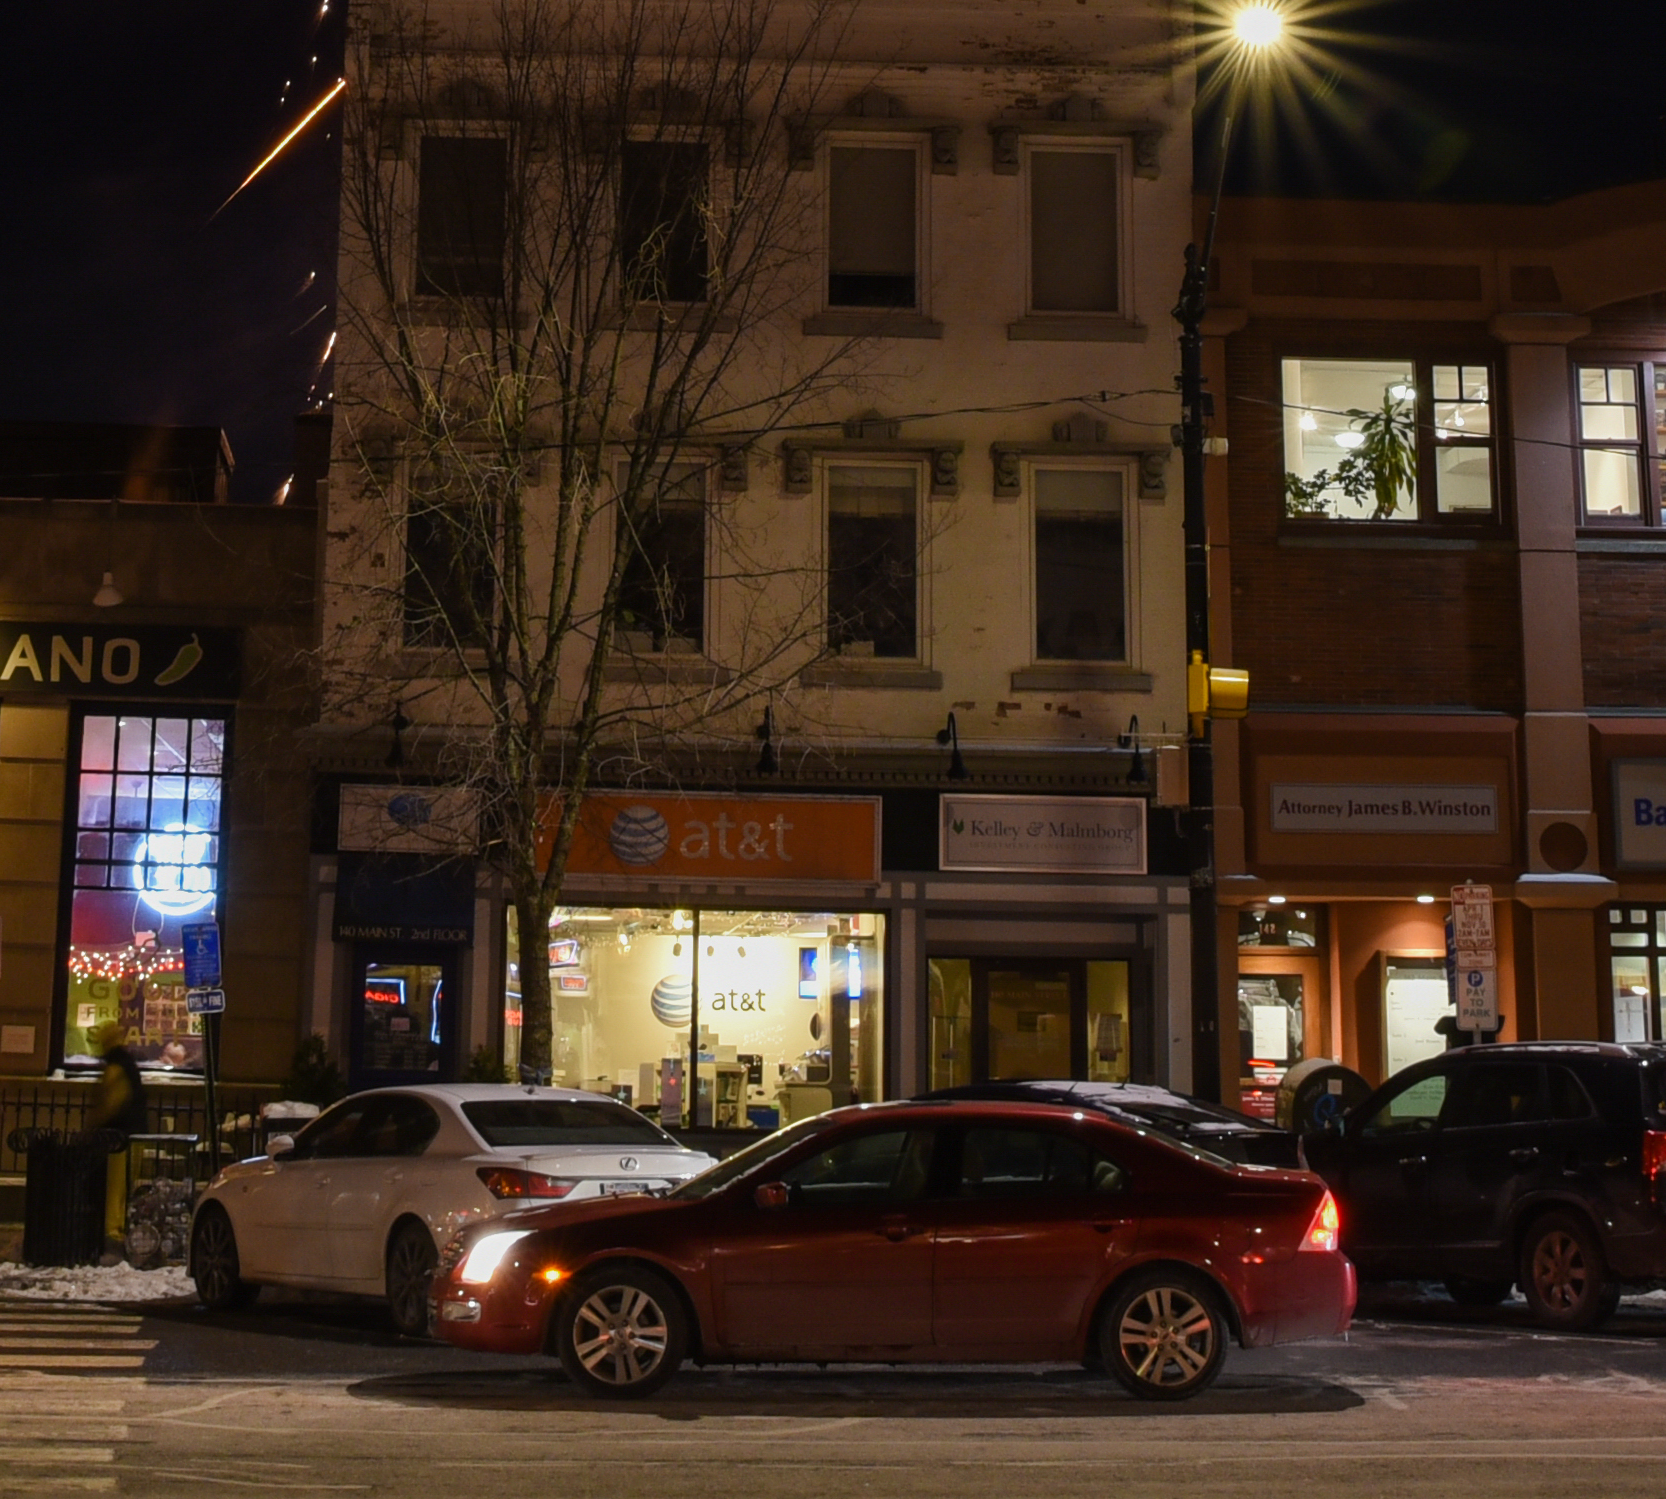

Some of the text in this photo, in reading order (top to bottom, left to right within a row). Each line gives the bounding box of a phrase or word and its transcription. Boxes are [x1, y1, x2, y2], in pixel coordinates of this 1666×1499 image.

[1278, 799, 1344, 818] Attorney
[1347, 800, 1399, 818] James
[1418, 800, 1491, 817] Winston
[679, 811, 795, 862] at&t
[970, 819, 1134, 843] Kelley & Malmborg
[338, 925, 356, 938] 140
[358, 926, 388, 939] MAIN
[410, 928, 430, 940] 2nd
[433, 928, 468, 942] FLOOR
[711, 988, 767, 1012] at&t
[1465, 988, 1486, 997] PAY
[1469, 998, 1484, 1007] TO
[86, 1005, 140, 1020] FROM
[1462, 1009, 1491, 1018] PARK
